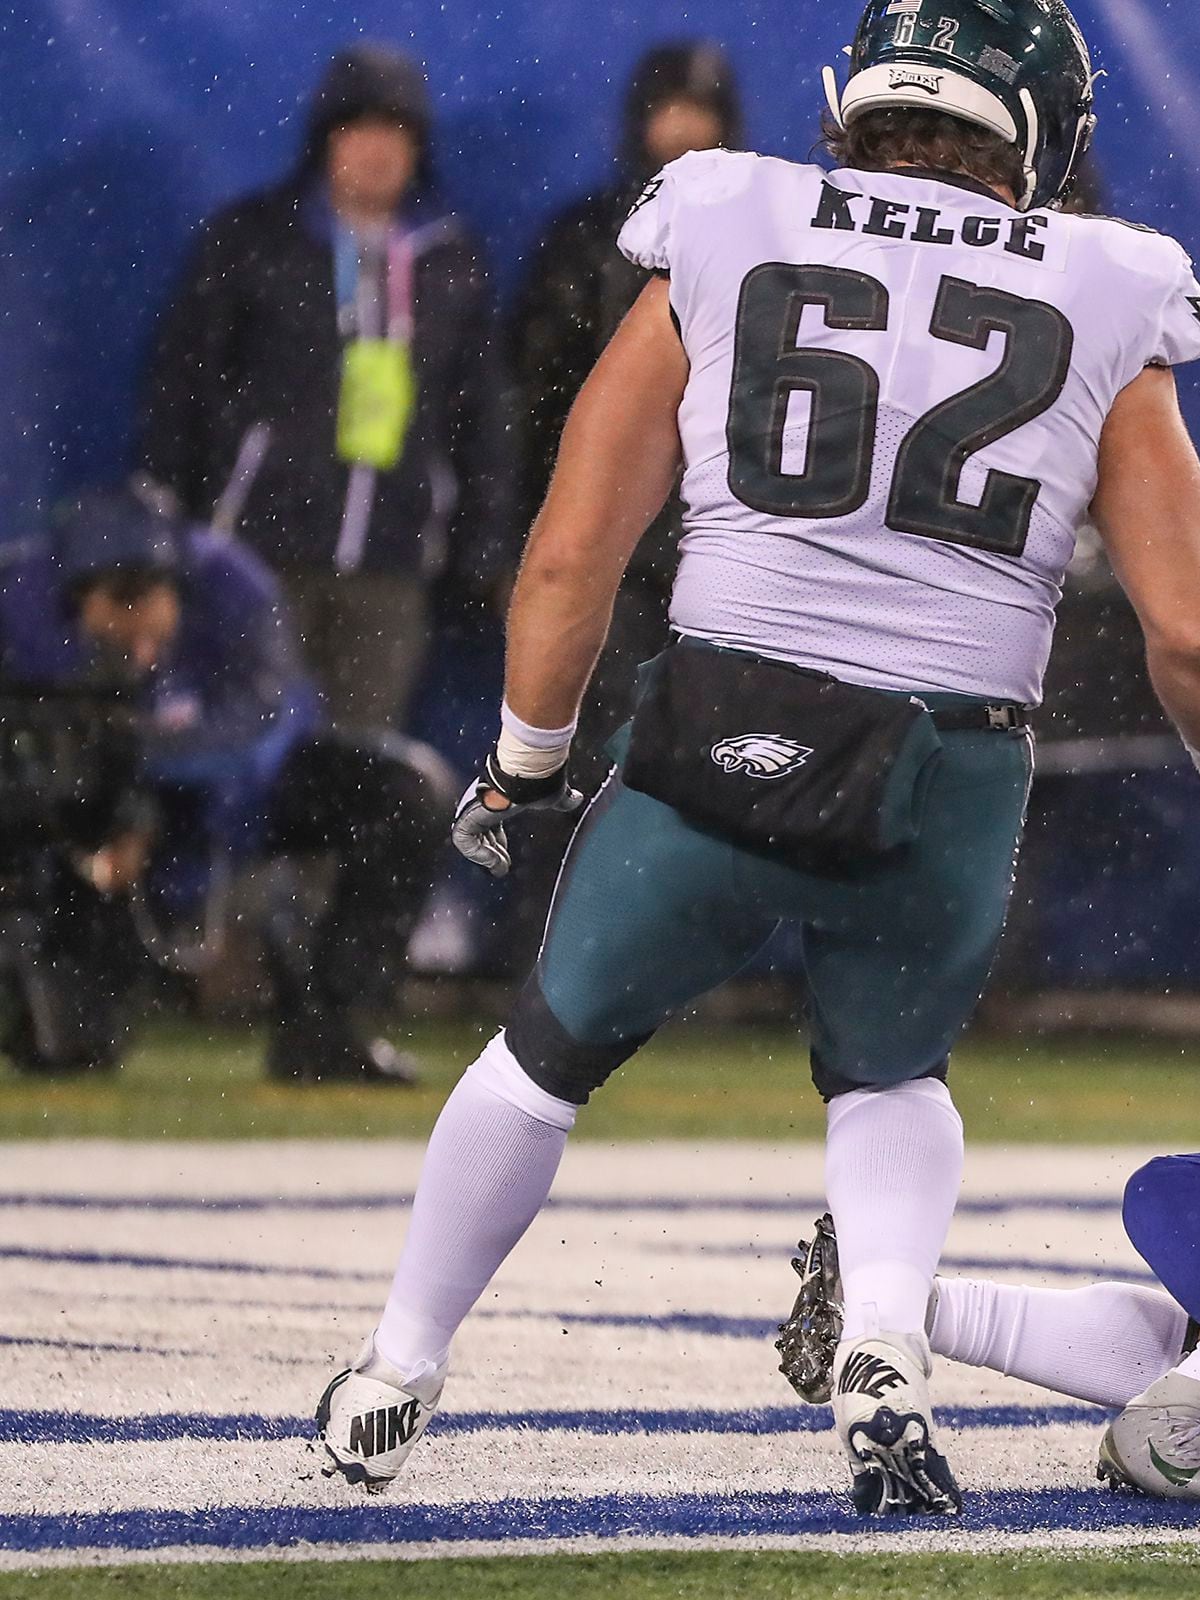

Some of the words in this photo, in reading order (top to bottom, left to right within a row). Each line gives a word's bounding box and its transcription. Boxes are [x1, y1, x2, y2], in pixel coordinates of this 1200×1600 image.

[893, 12, 960, 54] 62
[810, 179, 1048, 261] KELCE
[726, 262, 1074, 557] 62
[838, 1352, 908, 1399] NIKE
[349, 1400, 421, 1458] NIKE
